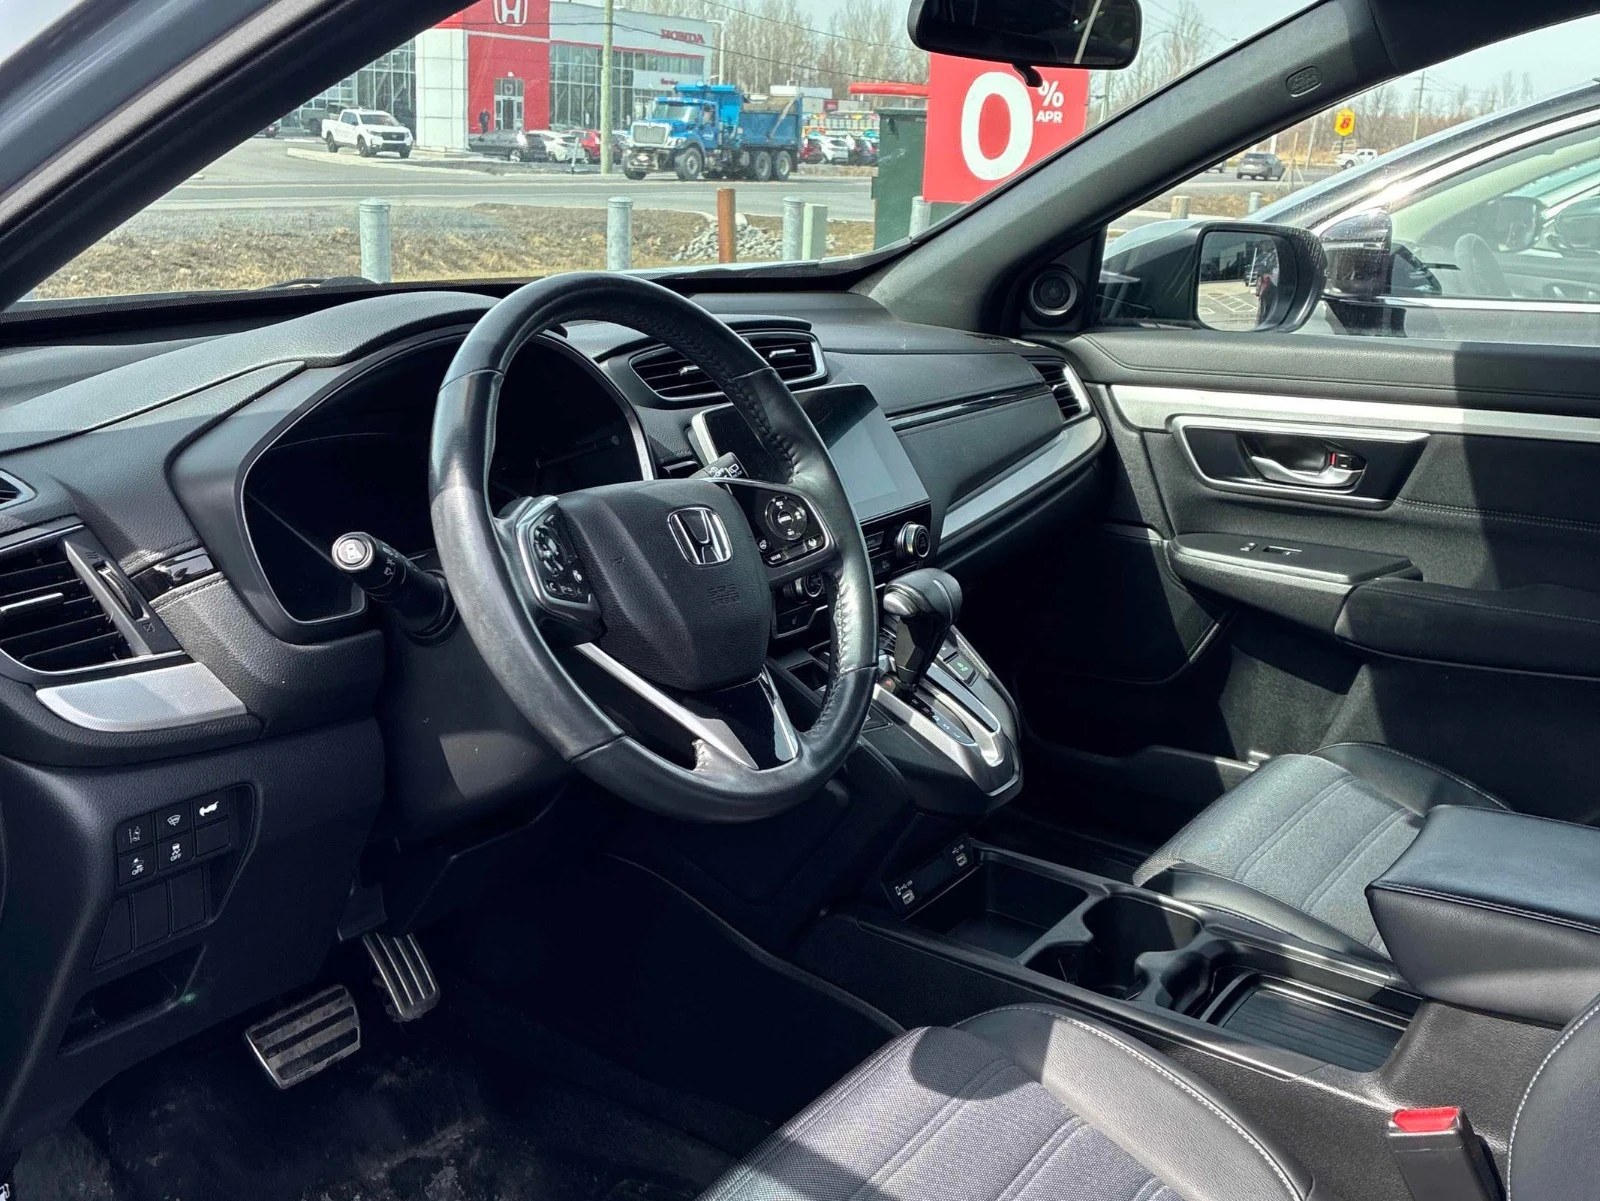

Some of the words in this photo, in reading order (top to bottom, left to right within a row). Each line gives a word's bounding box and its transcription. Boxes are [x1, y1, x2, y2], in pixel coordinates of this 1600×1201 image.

[661, 29, 705, 44] HONDA
[1036, 110, 1063, 123] APR
[961, 71, 1034, 181] 0
